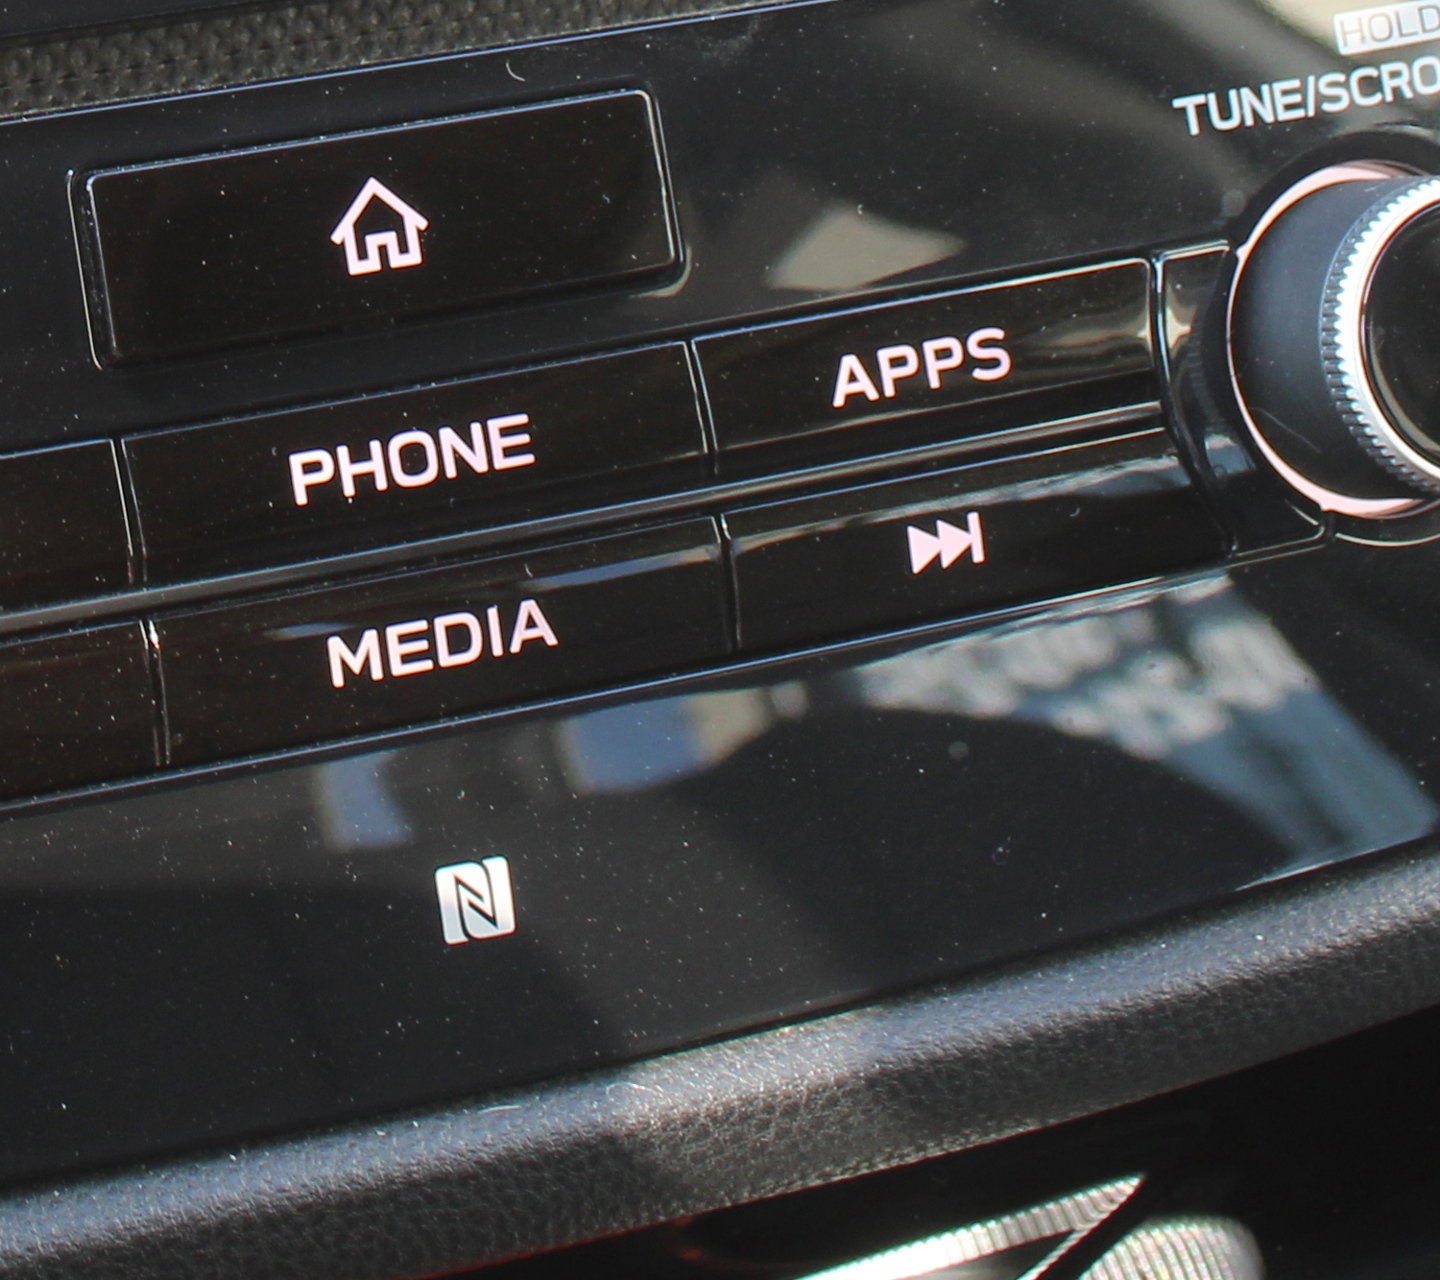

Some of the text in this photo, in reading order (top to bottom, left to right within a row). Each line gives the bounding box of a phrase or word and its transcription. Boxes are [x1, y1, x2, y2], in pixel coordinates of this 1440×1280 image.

[831, 326, 1012, 409] APPS
[288, 413, 537, 506] PHONE
[327, 598, 559, 688] MEDIA
